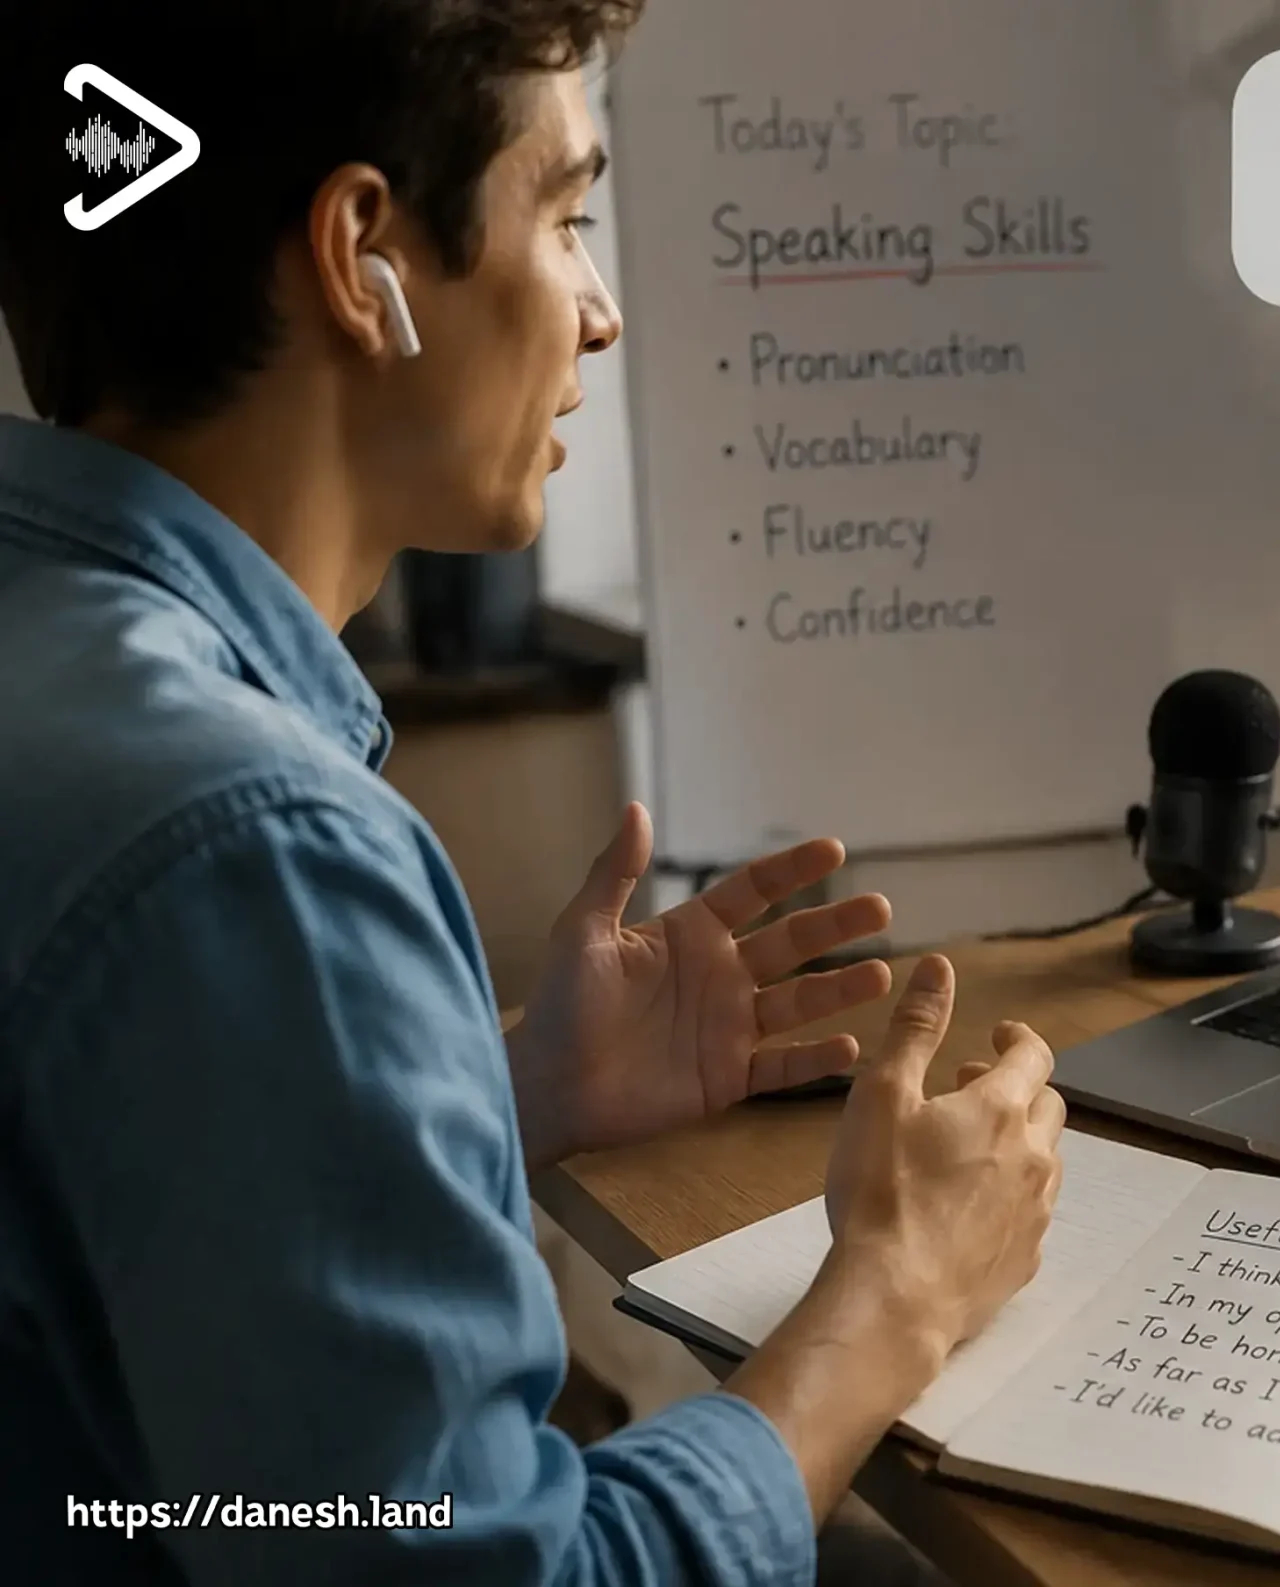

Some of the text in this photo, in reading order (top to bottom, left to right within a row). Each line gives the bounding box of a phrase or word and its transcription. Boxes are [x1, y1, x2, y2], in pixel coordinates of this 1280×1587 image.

[699, 94, 865, 173] Today's
[711, 196, 1094, 291] Speaking Skills
[751, 331, 1027, 386] Pronunciation
[753, 416, 982, 482] Vocabulary
[763, 503, 931, 570] Fluency
[765, 586, 996, 644] Confidence
[1181, 1324, 1218, 1350] be
[1208, 1297, 1253, 1325] my
[1155, 1356, 1202, 1384] far
[1213, 1375, 1245, 1395] as
[1258, 1379, 1280, 1401] I
[1131, 1392, 1185, 1423] like
[1202, 1409, 1233, 1431] to
